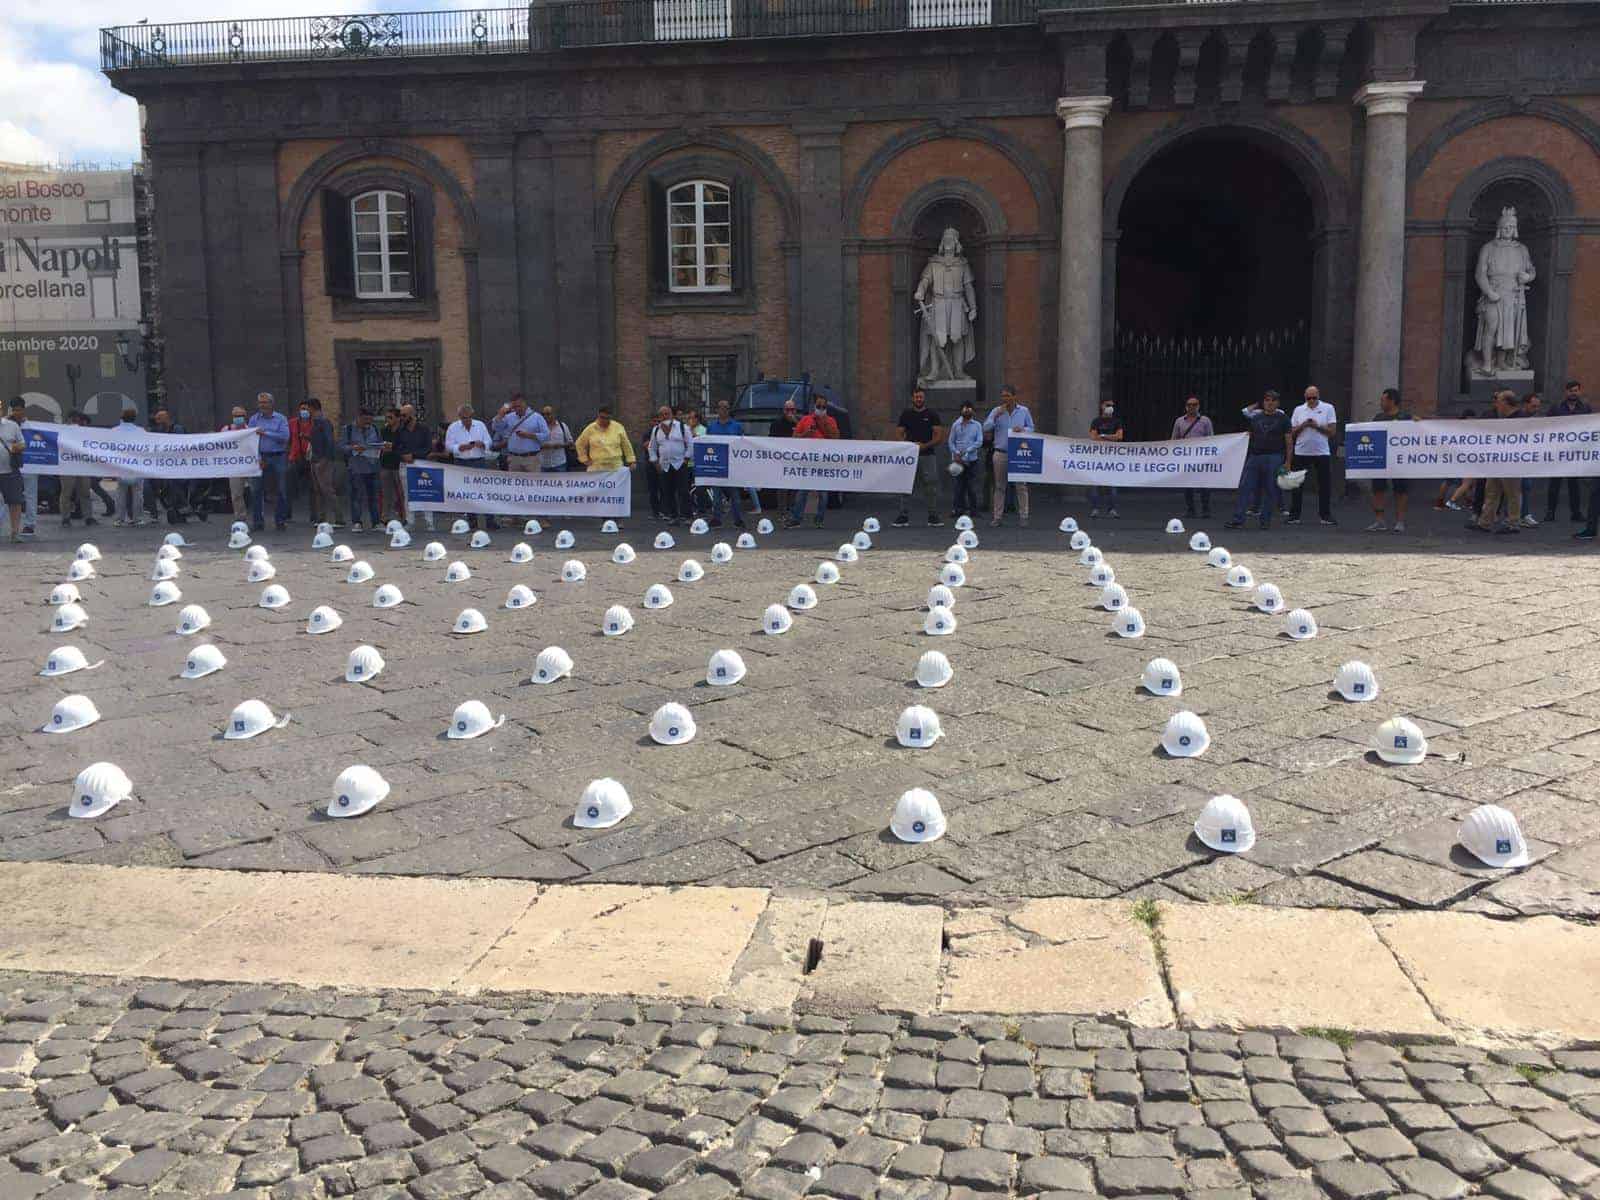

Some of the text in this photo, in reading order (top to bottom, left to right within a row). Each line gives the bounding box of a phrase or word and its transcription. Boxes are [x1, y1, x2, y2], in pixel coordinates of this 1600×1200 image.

[26, 180, 85, 198] Bosco
[13, 235, 121, 278] Napoli
[0, 336, 98, 351] tembre 2020
[82, 440, 148, 452] ECOBONUS
[163, 441, 239, 452] SISMABONUS
[1389, 431, 1600, 447] CON LE PAROLE NON SI PROGE
[732, 449, 915, 466] VOI SBLOCCATE NOI RIPARTIAMO
[1069, 445, 1218, 456] SEMPLIFICHIAMO GLI ITER
[1397, 450, 1600, 464] E NON SI COSTRUISCE IL FUTUR
[61, 452, 138, 465] GHIGLIOTTINA
[143, 458, 152, 466] O
[155, 458, 188, 466] ISOLA
[191, 458, 208, 466] DEL
[1062, 460, 1222, 472] TAGLIAMO LE LEGGI INUTILI
[783, 466, 808, 476] FATE
[811, 468, 850, 478] PRESTO
[463, 476, 616, 488] IL MOTORE DELL'ITALIA SIAMO NOI
[448, 491, 484, 500] MANCA
[486, 492, 512, 502] SOLO
[514, 494, 525, 502] LA
[528, 494, 566, 503] BENZINA
[568, 496, 586, 504] PER
